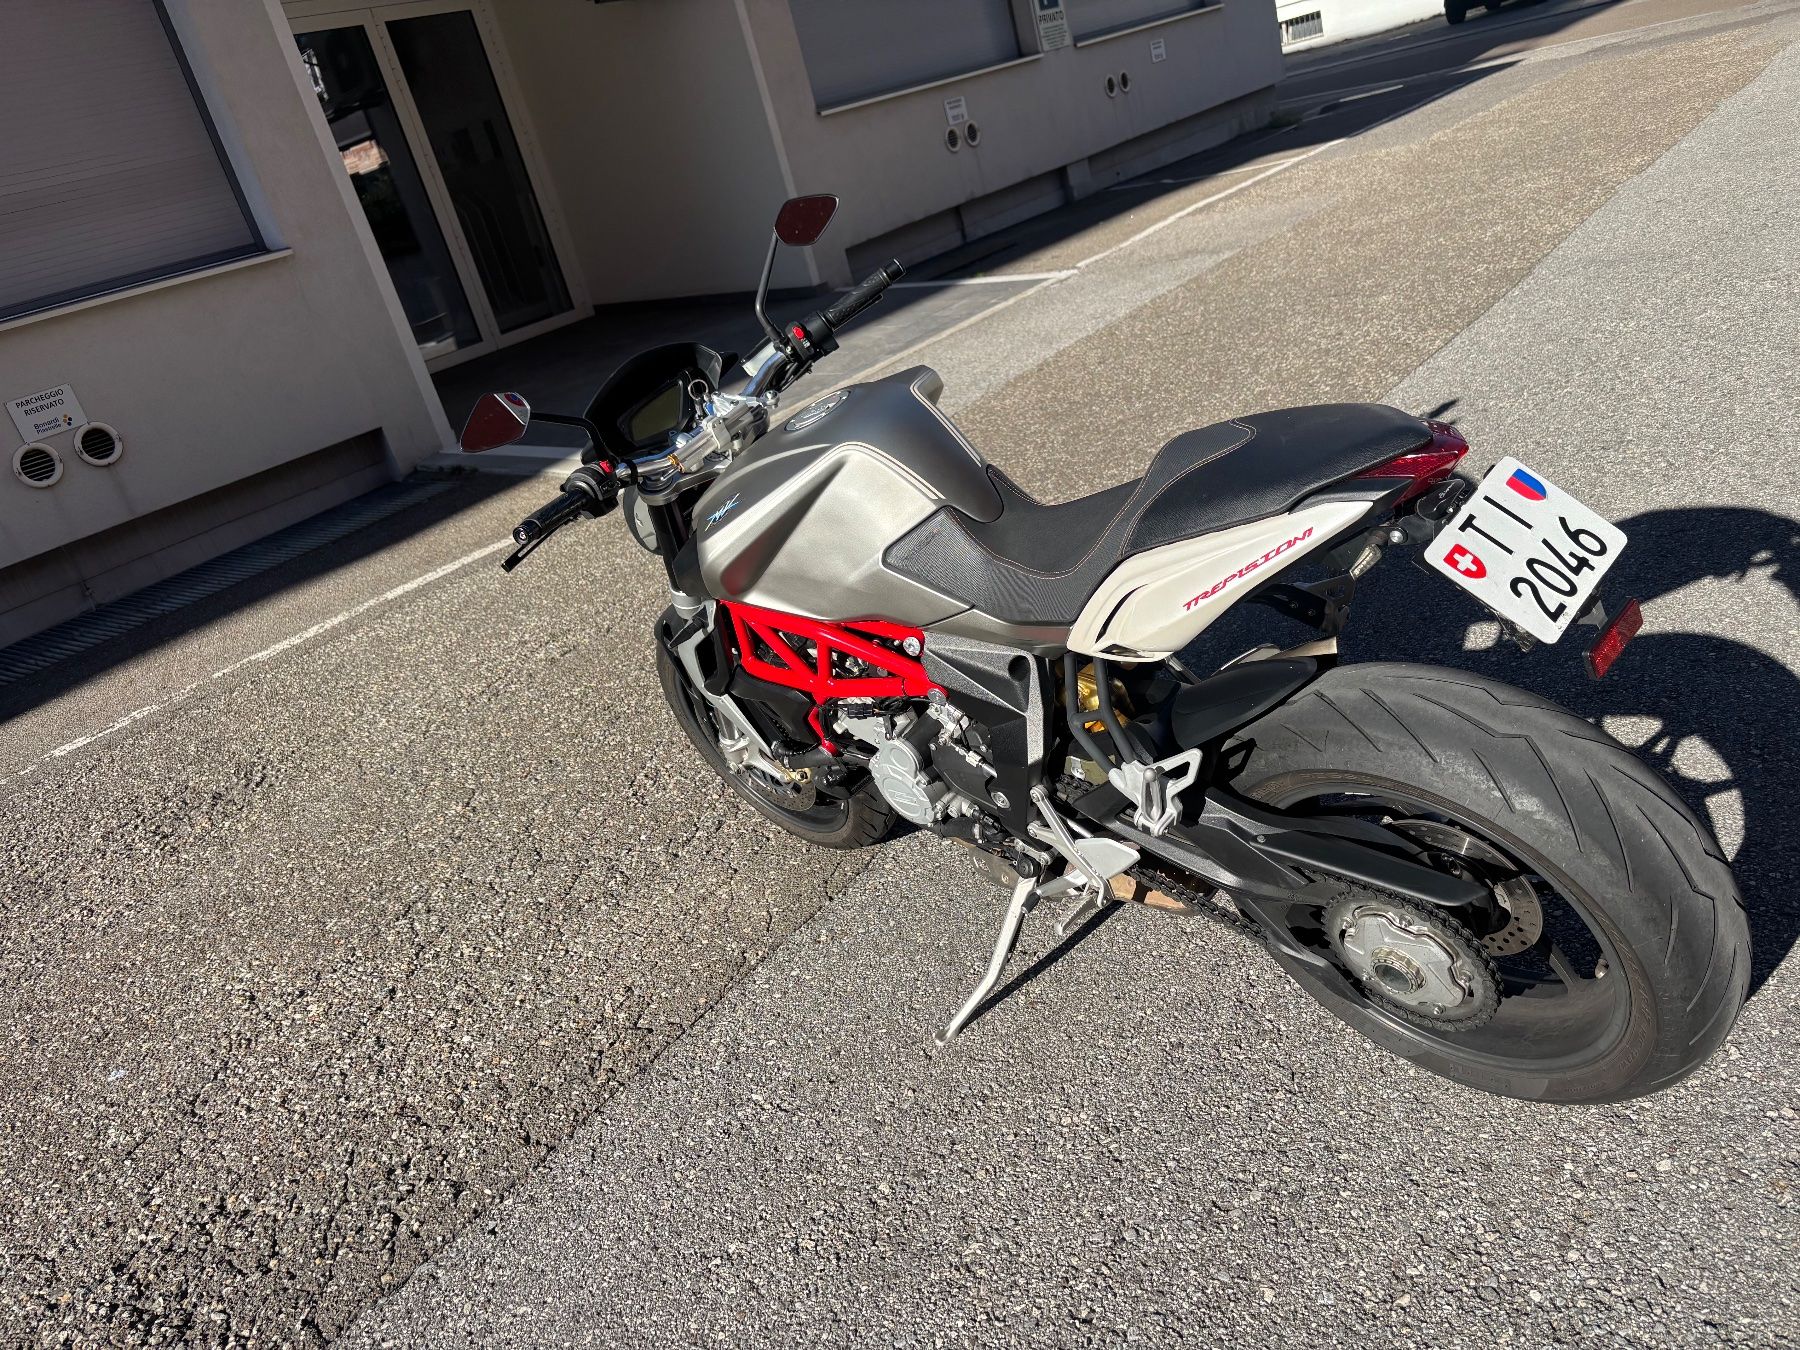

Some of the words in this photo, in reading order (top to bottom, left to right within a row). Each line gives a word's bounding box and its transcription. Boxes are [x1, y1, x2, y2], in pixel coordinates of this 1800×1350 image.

[15, 388, 64, 409] PARCHEGGIO
[23, 398, 65, 417] RISERVATO
[33, 416, 60, 430] Bonardi
[1182, 526, 1314, 612] TREPISTONI
[1509, 516, 1608, 623] 2046
